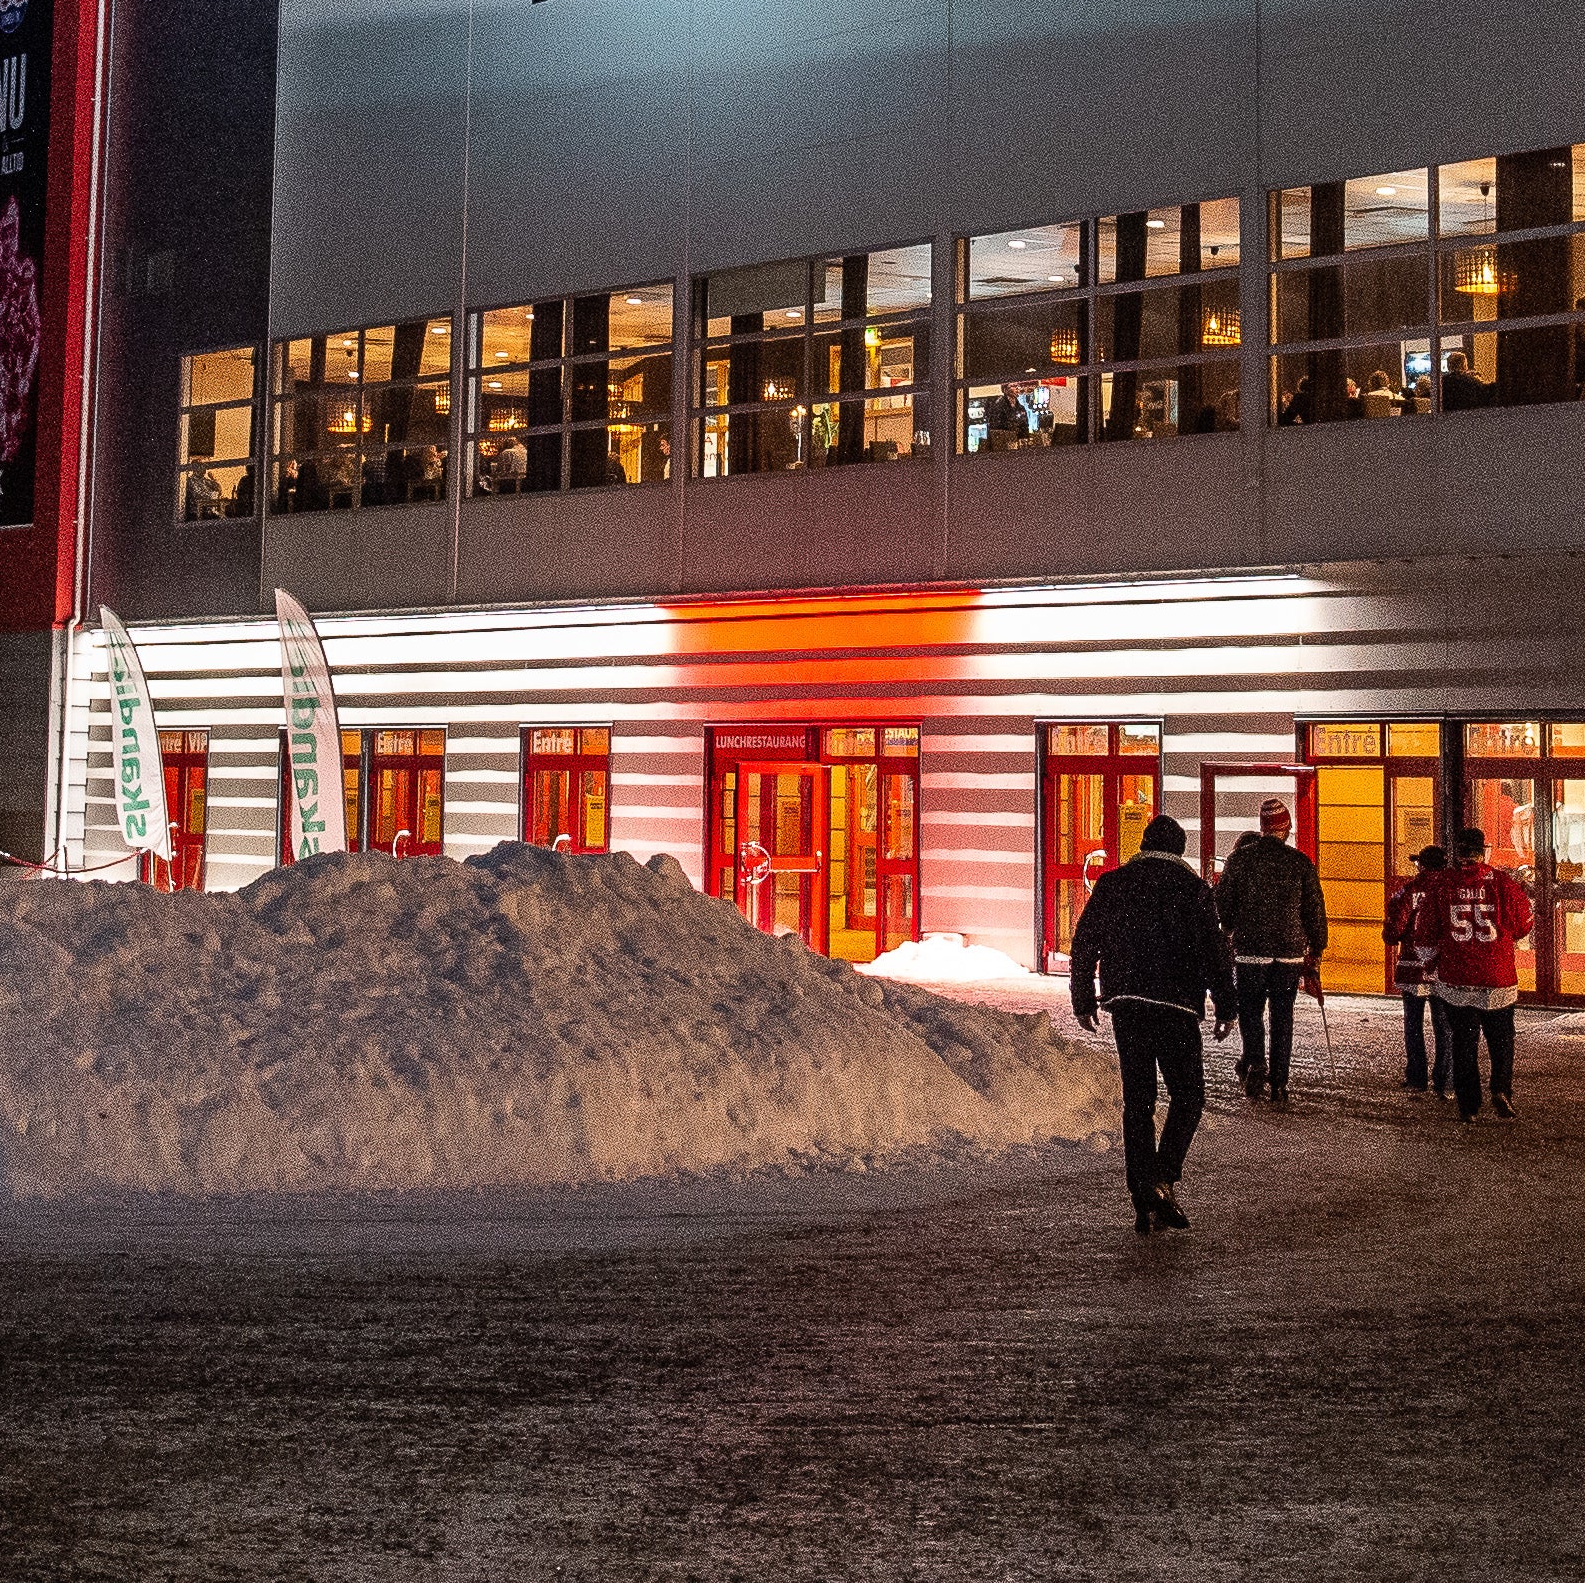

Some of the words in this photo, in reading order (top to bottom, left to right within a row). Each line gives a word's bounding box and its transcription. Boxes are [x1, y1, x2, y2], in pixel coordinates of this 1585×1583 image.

[715, 734, 806, 749] LUNCHRESTAURANG
[1314, 725, 1376, 754] Entré
[1450, 903, 1499, 943] 55
